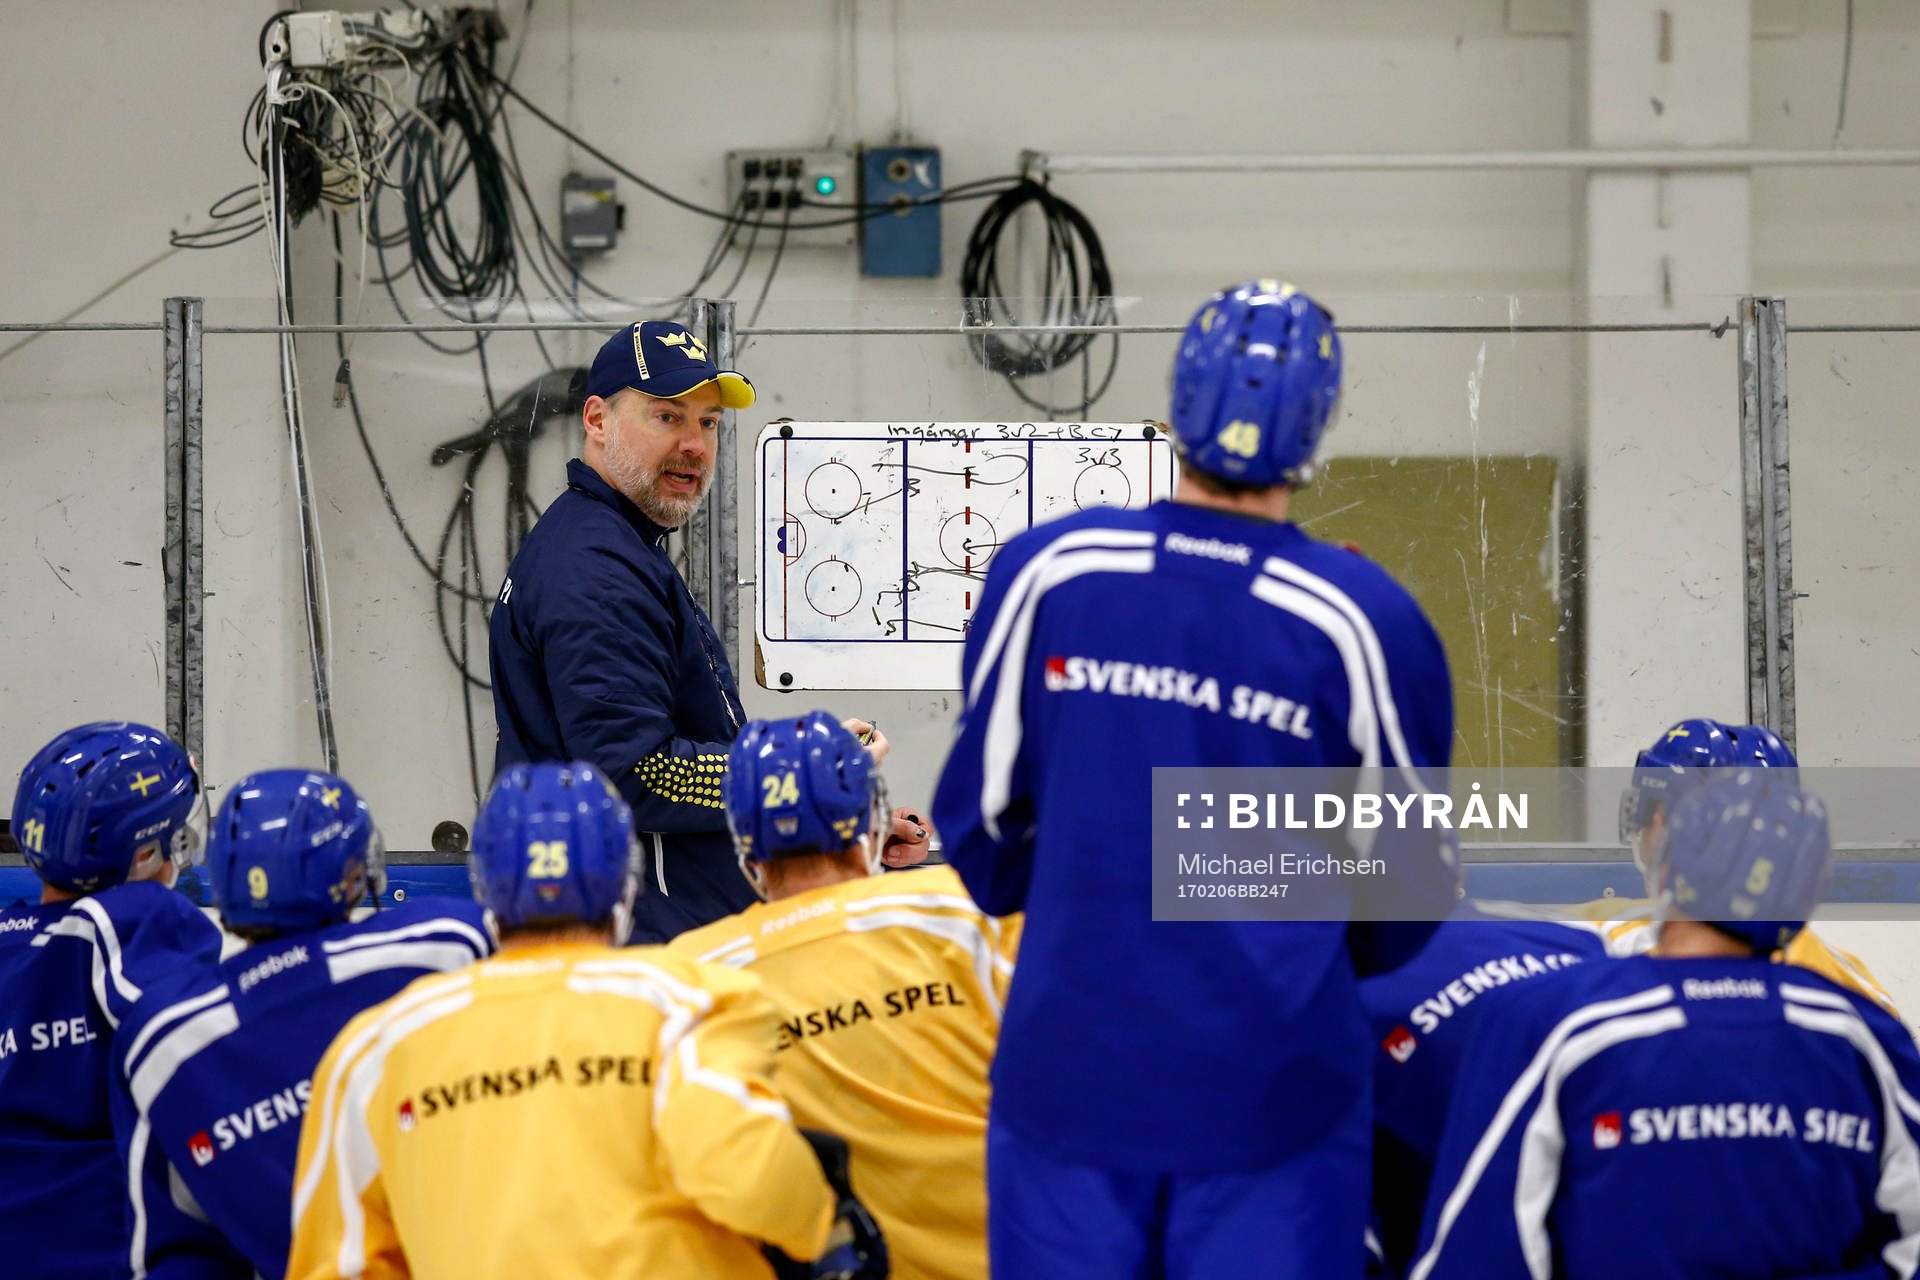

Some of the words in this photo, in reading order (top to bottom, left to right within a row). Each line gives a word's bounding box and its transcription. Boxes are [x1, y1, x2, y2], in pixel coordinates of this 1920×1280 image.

[1065, 656, 1221, 713] SVENSKA
[1228, 684, 1314, 740] SPEL
[762, 772, 800, 809] 24
[24, 818, 45, 853] 11
[527, 841, 569, 878] 25
[248, 866, 269, 900] 9
[884, 982, 966, 1018] SPEL
[1410, 953, 1548, 1034] SVENSKA
[30, 1014, 97, 1051] SPEL
[1629, 1102, 1797, 1145] SVENSKA
